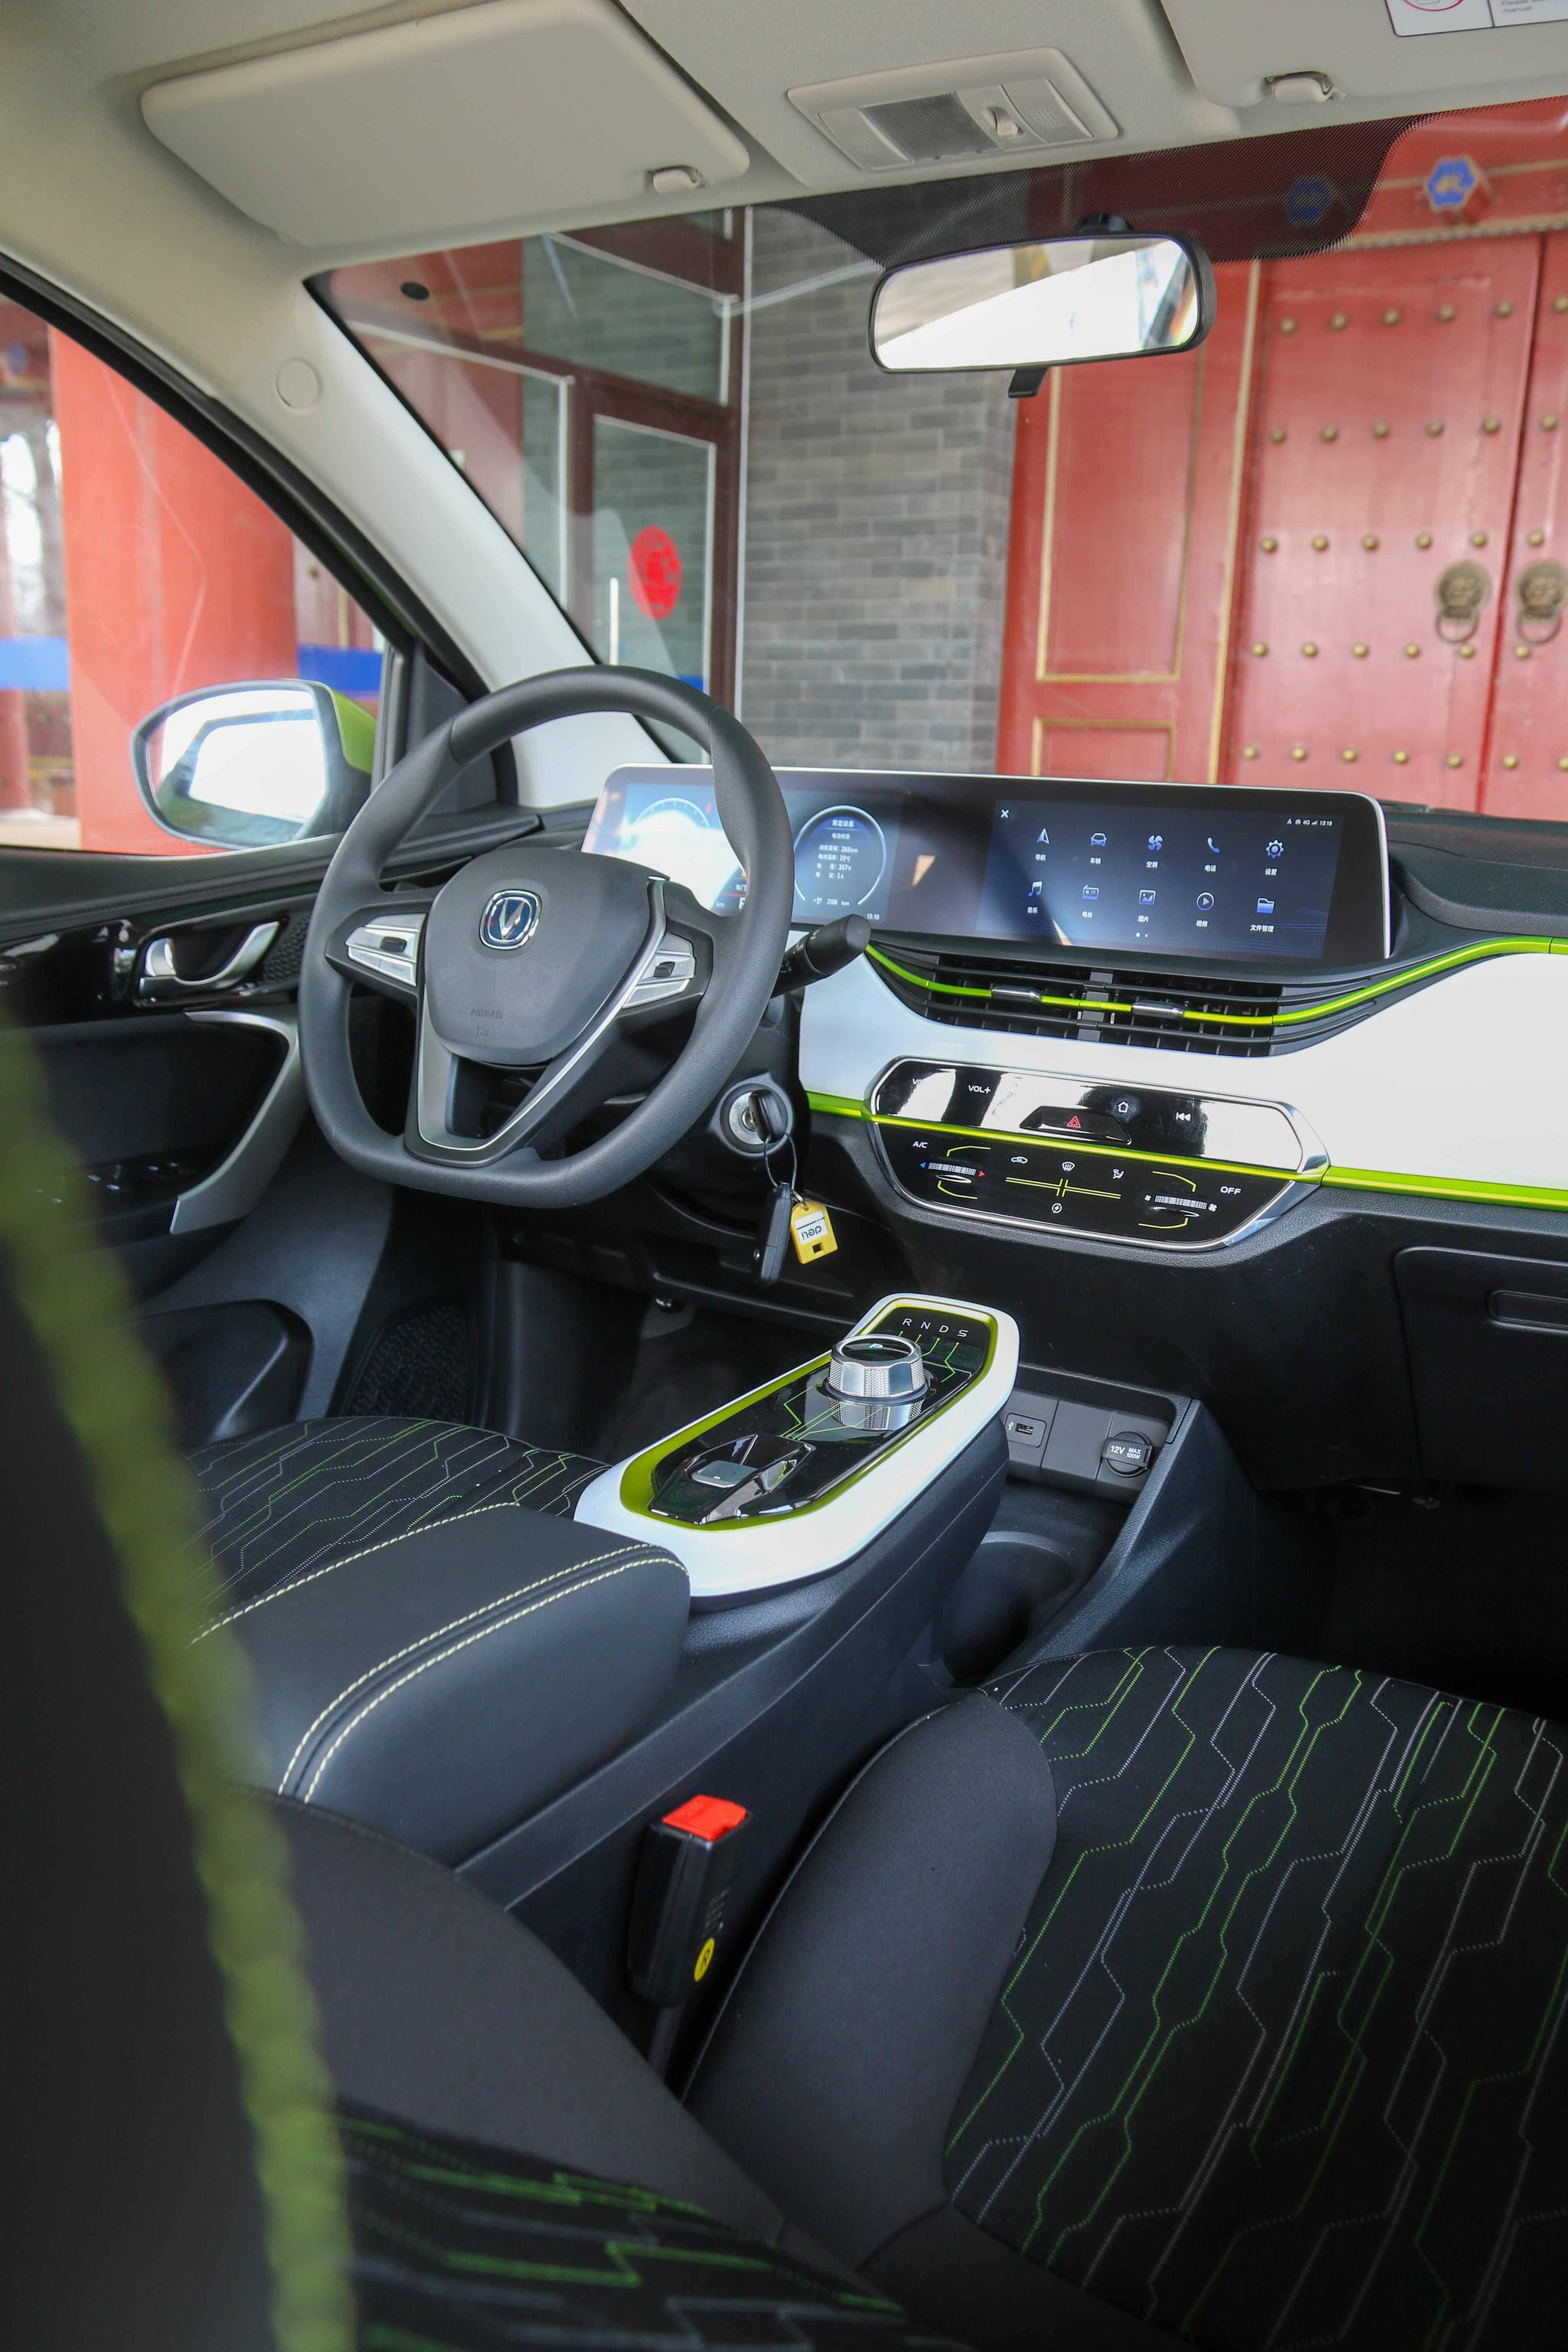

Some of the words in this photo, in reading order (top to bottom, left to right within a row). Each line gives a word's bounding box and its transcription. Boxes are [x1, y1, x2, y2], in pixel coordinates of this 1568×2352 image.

[1035, 853, 1047, 861] 导航
[1089, 857, 1102, 865] 车辆
[1145, 861, 1158, 869] 空调
[1204, 864, 1217, 873] 电话
[1265, 867, 1278, 876] 设置
[1081, 910, 1093, 919] 电台
[1138, 915, 1150, 923] 图片
[1196, 920, 1208, 928] 视频
[1250, 924, 1275, 933] 文件管理
[968, 1084, 991, 1094] VOL+
[912, 1140, 928, 1149] A/C
[1220, 1186, 1242, 1195] OFF
[801, 1225, 822, 1240] deli
[1110, 1445, 1125, 1455] 12V
[1126, 1452, 1141, 1460] 120W
